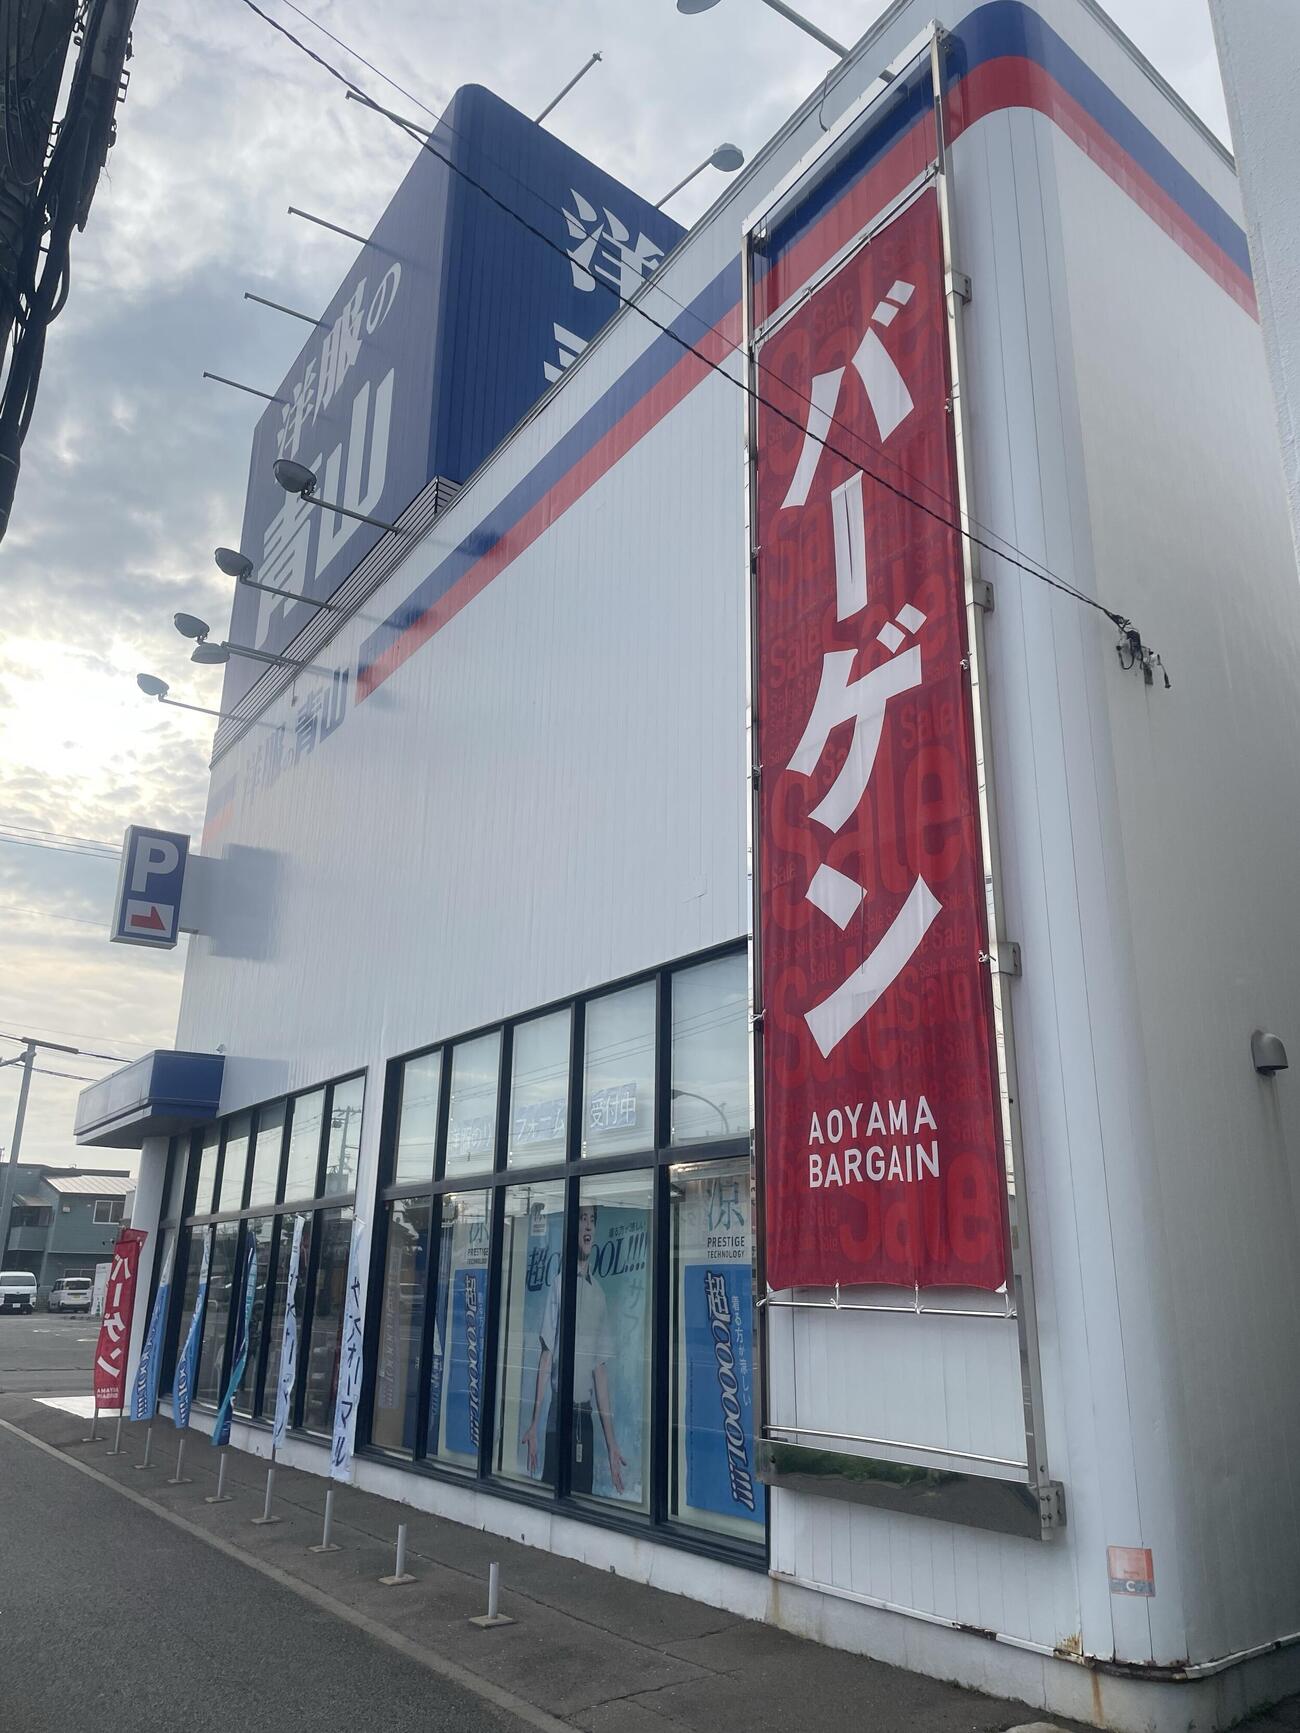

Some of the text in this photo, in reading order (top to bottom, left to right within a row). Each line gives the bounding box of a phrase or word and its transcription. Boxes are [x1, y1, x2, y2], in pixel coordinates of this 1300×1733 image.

[275, 262, 401, 470] 洋服の
[254, 368, 395, 650] 青山
[780, 280, 942, 1059] バーゲン
[131, 835, 179, 893] P
[590, 1091, 636, 1129] 受付中
[808, 1096, 938, 1146] AOYAMA
[808, 1140, 940, 1188] BARGAIN
[707, 1236, 745, 1248] PRESTIGE
[707, 1250, 745, 1259] TECHNOLOGY
